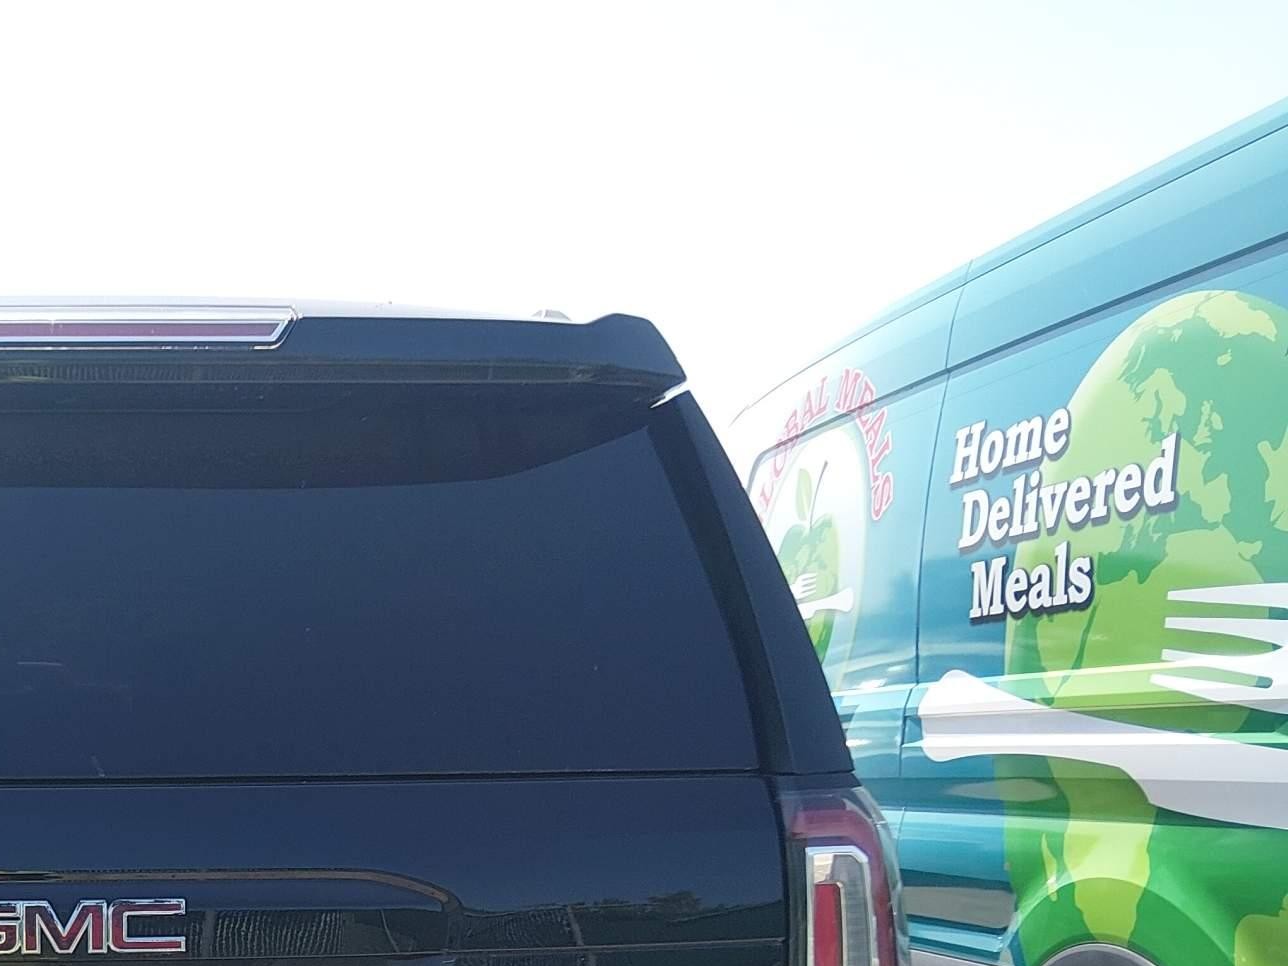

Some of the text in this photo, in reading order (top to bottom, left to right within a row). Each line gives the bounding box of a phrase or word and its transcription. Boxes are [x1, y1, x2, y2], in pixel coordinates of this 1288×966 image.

[758, 368, 893, 525] LOBAL MEALS
[948, 407, 1071, 487] Home
[957, 431, 1179, 551] Delivered
[968, 540, 1093, 621] Meals
